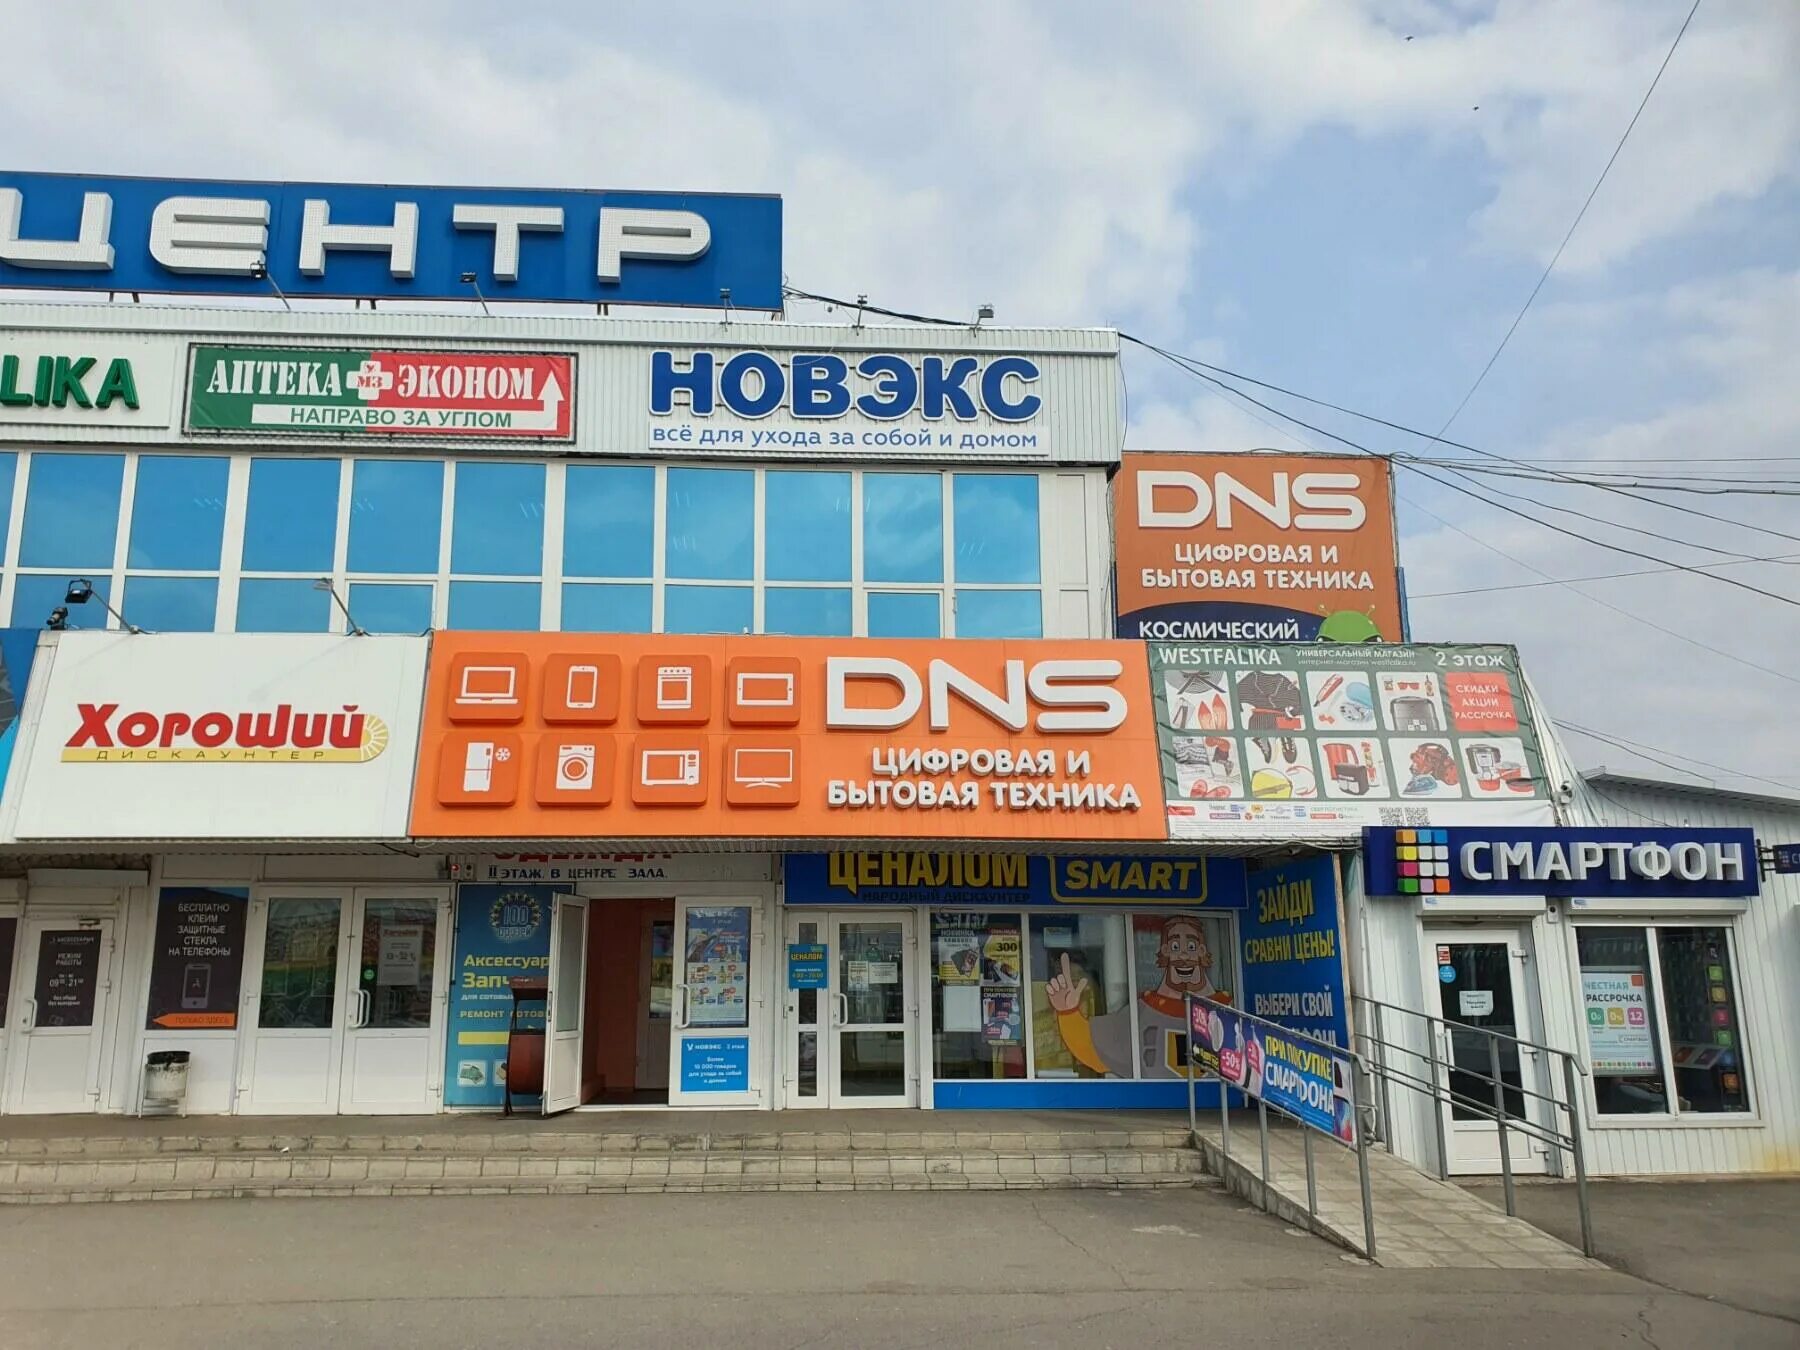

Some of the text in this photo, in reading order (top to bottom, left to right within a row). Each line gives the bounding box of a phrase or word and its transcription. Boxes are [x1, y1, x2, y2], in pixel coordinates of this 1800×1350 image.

[0, 187, 712, 285] ЦЕНТР
[0, 355, 140, 410] LIKA
[206, 359, 343, 396] АПТЕКА
[397, 364, 534, 400] ЭКОНОМ
[649, 350, 1044, 422] НОВЭКС
[290, 407, 512, 428] НАПРАВО ЗА УГЛОМ
[652, 424, 1037, 450] всё для ухода за собой и домом
[1136, 470, 1367, 531] DNS
[1174, 543, 1339, 567] ЦИФРОВАЯ И
[1141, 568, 1374, 590] БЫТОВАЯ ТЕХНИКА
[1138, 617, 1299, 640] КОСМИЧЕСКИЙ
[1158, 647, 1282, 665] WESTFALIKA
[1295, 648, 1371, 659] УНИВЕРСАЛЬНЫЙ
[1435, 652, 1505, 668] 2 этаж
[825, 655, 1129, 733] DNS
[1455, 684, 1499, 694] СКИДКИ
[1461, 697, 1499, 708] АКЦИИ
[1454, 711, 1512, 720] РАССРОЧКА
[65, 703, 366, 749] Хороший
[96, 750, 324, 761] ДИСКАУНТЕР
[872, 745, 1091, 777] ЦИФРОВАЯ И
[826, 779, 1142, 811] БЫТОВАЯ ТЕХНИКА
[1460, 842, 1745, 882] СМАРТФОН
[550, 868, 561, 879] В
[568, 868, 616, 880] ЦЕНТРЕ
[828, 851, 1029, 896] ЦЕНАЛОМ
[1065, 859, 1198, 891] SMART
[862, 890, 1031, 902] НАРОДНЫЙ ДИСКАУНТЕР
[1256, 874, 1315, 927] ЗАЙДИ
[178, 903, 230, 913] БЕСПЛАТНО
[503, 905, 529, 925] 100
[187, 914, 218, 923] КЛЕИМ
[177, 925, 226, 935] ЗАЩИТНЫЕ
[183, 936, 218, 945] СТЕКЛА
[996, 942, 1017, 952] 300
[1244, 928, 1335, 965] СРАВНИ ЦЕНЫ!
[168, 946, 231, 956] НА ТЕЛЕФОНЫ
[463, 954, 550, 969] Аксессуар
[1584, 981, 1629, 990] ЧЕСТНАЯ
[1254, 984, 1334, 1017] ВЫБЕРИ СВОЙ
[1586, 994, 1643, 1002] РАССРОЧКА
[459, 1010, 505, 1018] РЕМОНТ
[1630, 1011, 1643, 1021] 12
[1265, 1035, 1287, 1060] ПРИ
[1221, 1053, 1241, 1072] -50%
